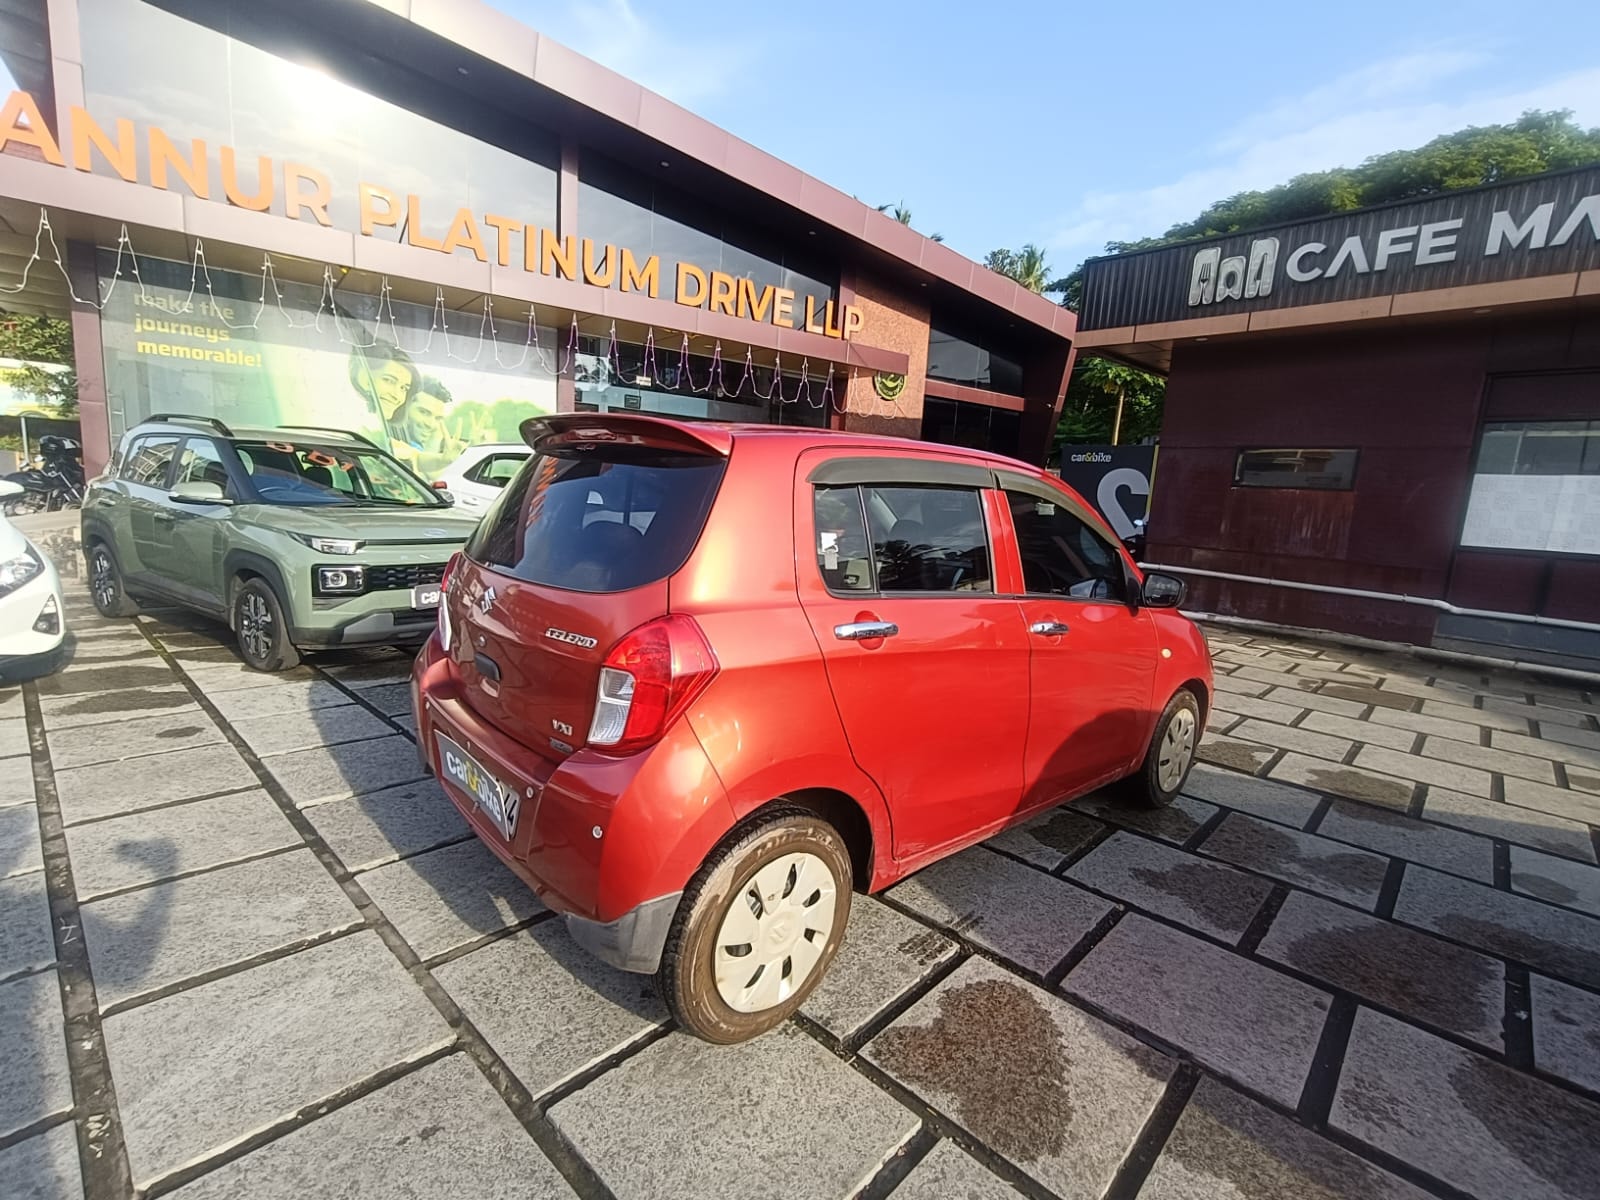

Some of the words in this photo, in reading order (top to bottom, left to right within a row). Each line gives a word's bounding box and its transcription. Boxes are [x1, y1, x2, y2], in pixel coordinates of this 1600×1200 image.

[0, 90, 333, 227] ANNUR
[358, 181, 660, 299] PLATINUM
[676, 262, 795, 328] DRIVE
[805, 295, 865, 340] LLP
[1285, 218, 1463, 282] CAFE
[133, 292, 194, 314] make
[200, 300, 235, 320] the
[134, 313, 231, 343] journeys
[136, 341, 262, 367] memorable!
[1070, 452, 1112, 463] car&bike
[445, 750, 502, 823] car&bike
